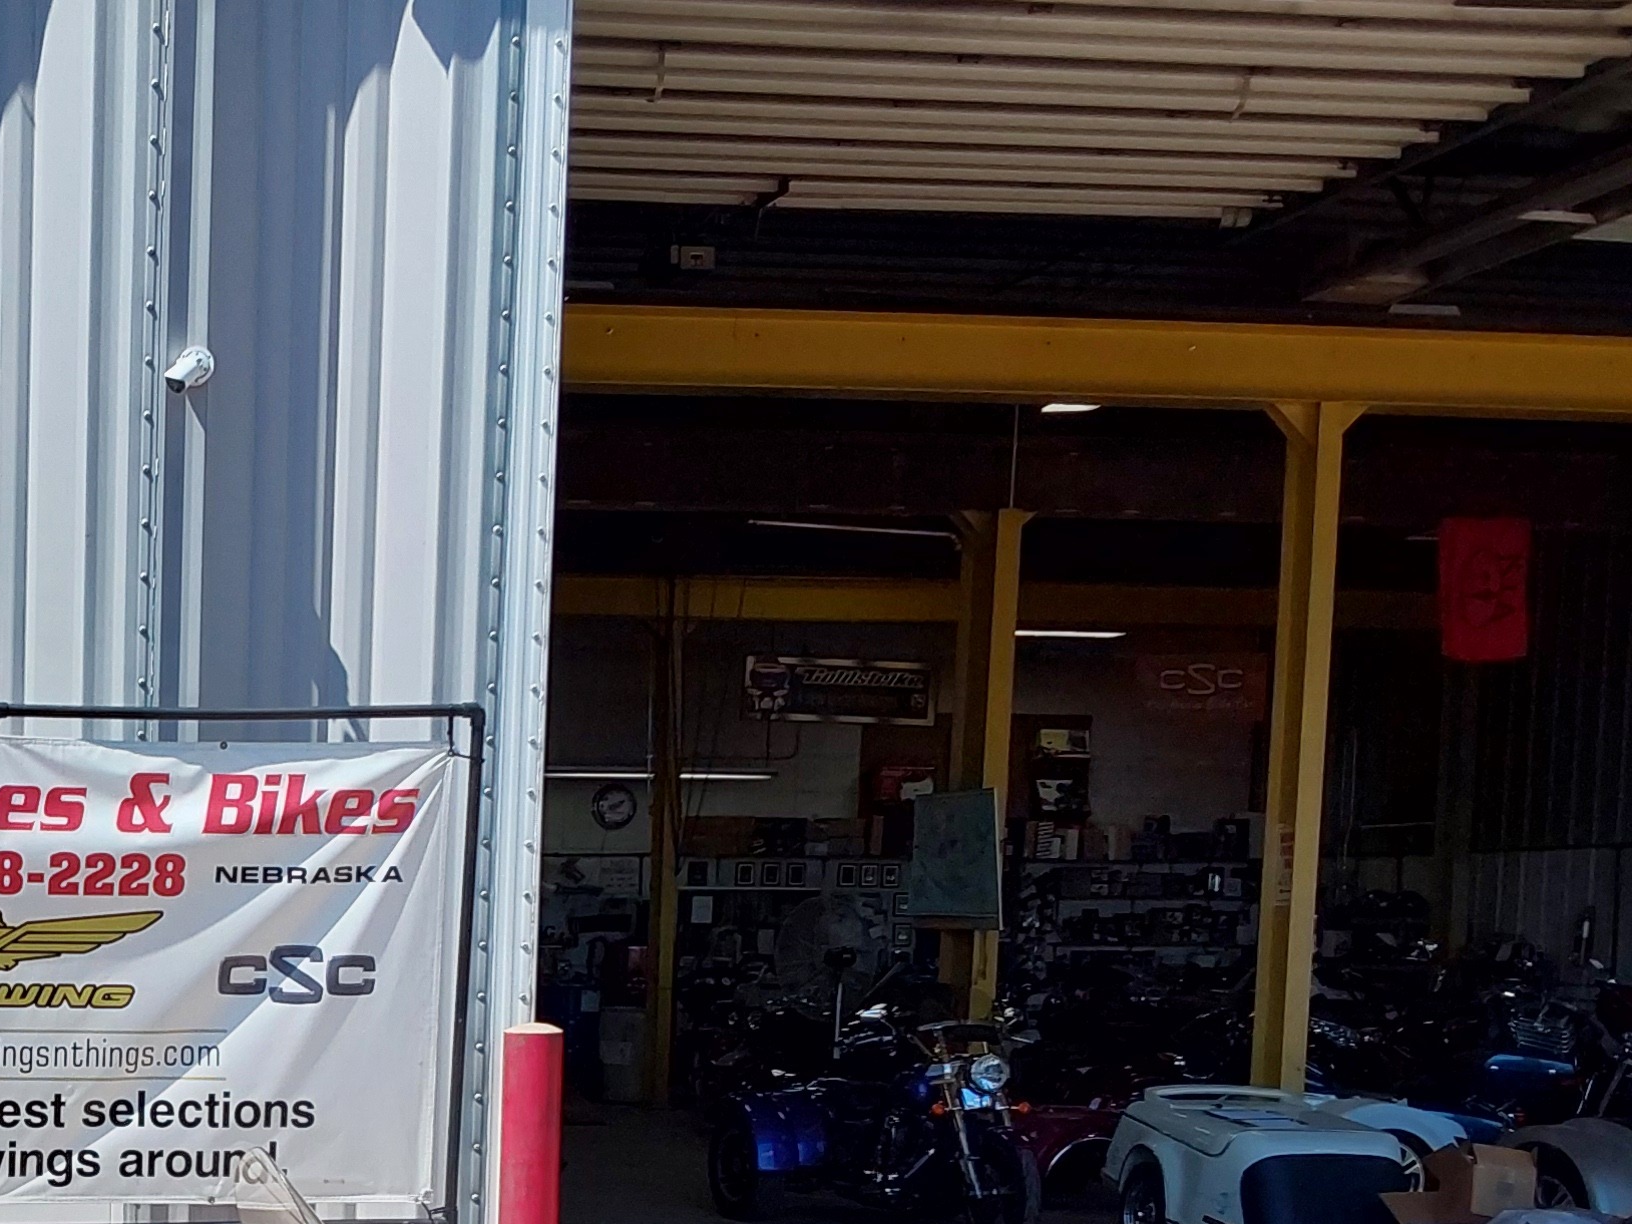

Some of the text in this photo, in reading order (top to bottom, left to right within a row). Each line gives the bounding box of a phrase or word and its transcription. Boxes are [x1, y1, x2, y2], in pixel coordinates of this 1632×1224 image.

[116, 773, 172, 834] &
[202, 773, 419, 835] Bikes
[215, 865, 403, 883] NEBRASKA
[81, 1091, 315, 1128] selections
